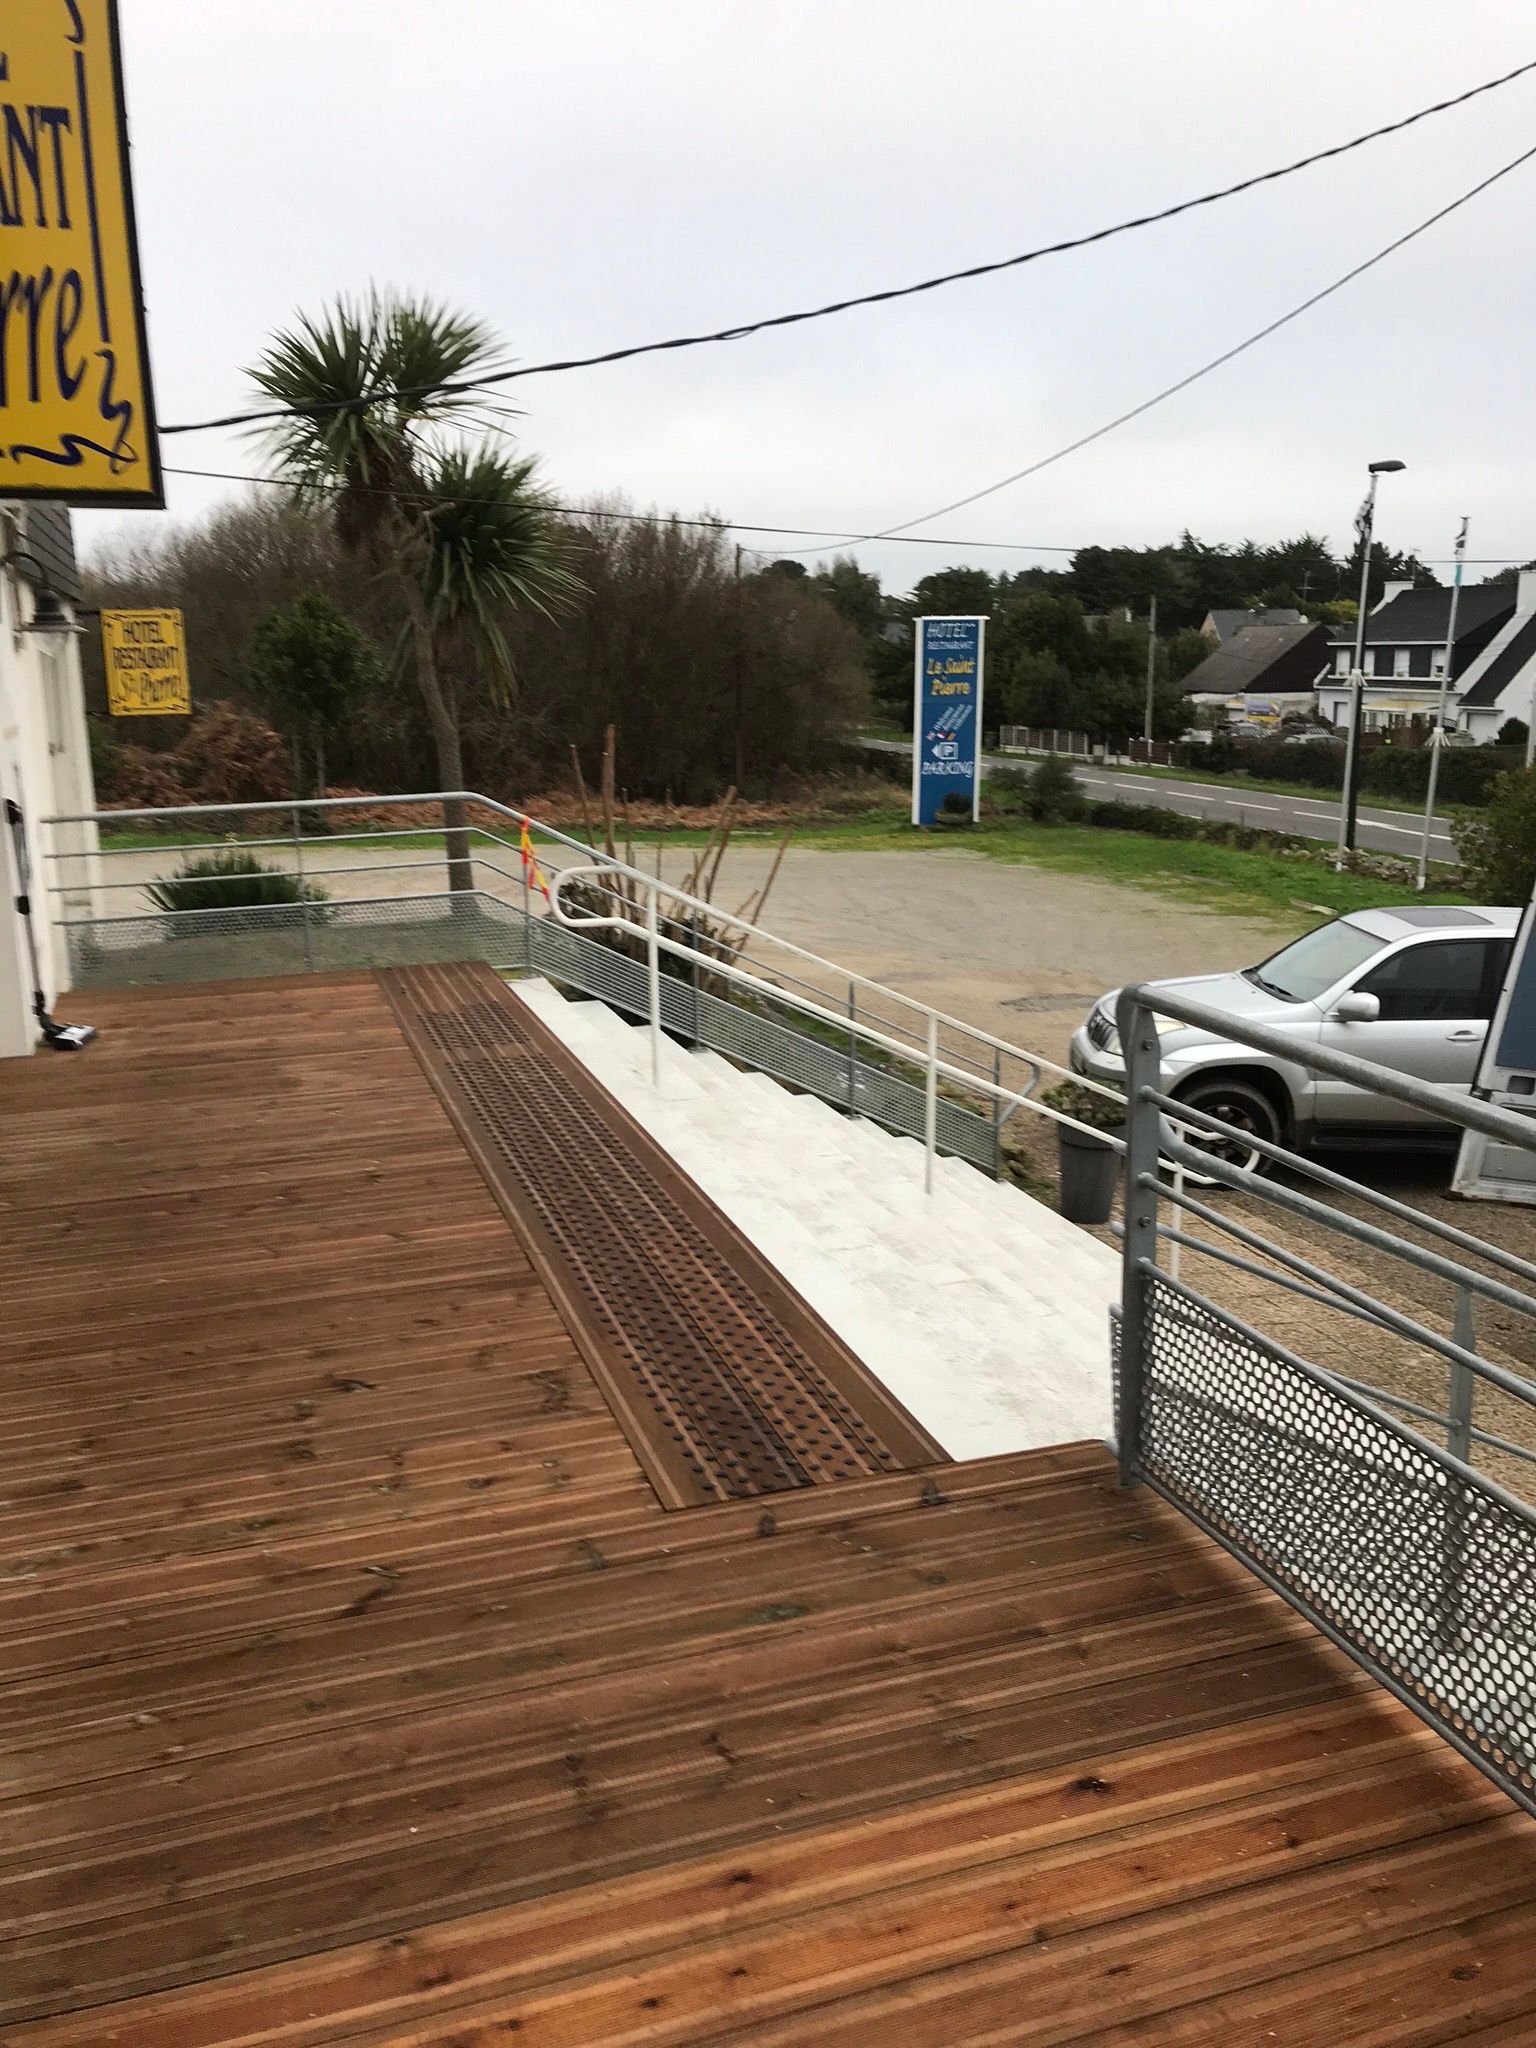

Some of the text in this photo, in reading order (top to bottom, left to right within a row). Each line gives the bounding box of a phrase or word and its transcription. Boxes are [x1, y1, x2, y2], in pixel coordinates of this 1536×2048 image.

[122, 620, 166, 644] HOTEL
[927, 623, 970, 638] HOTEL
[926, 655, 976, 675] Le Saint
[931, 676, 971, 696] Pierre
[921, 761, 974, 778] PARKING
